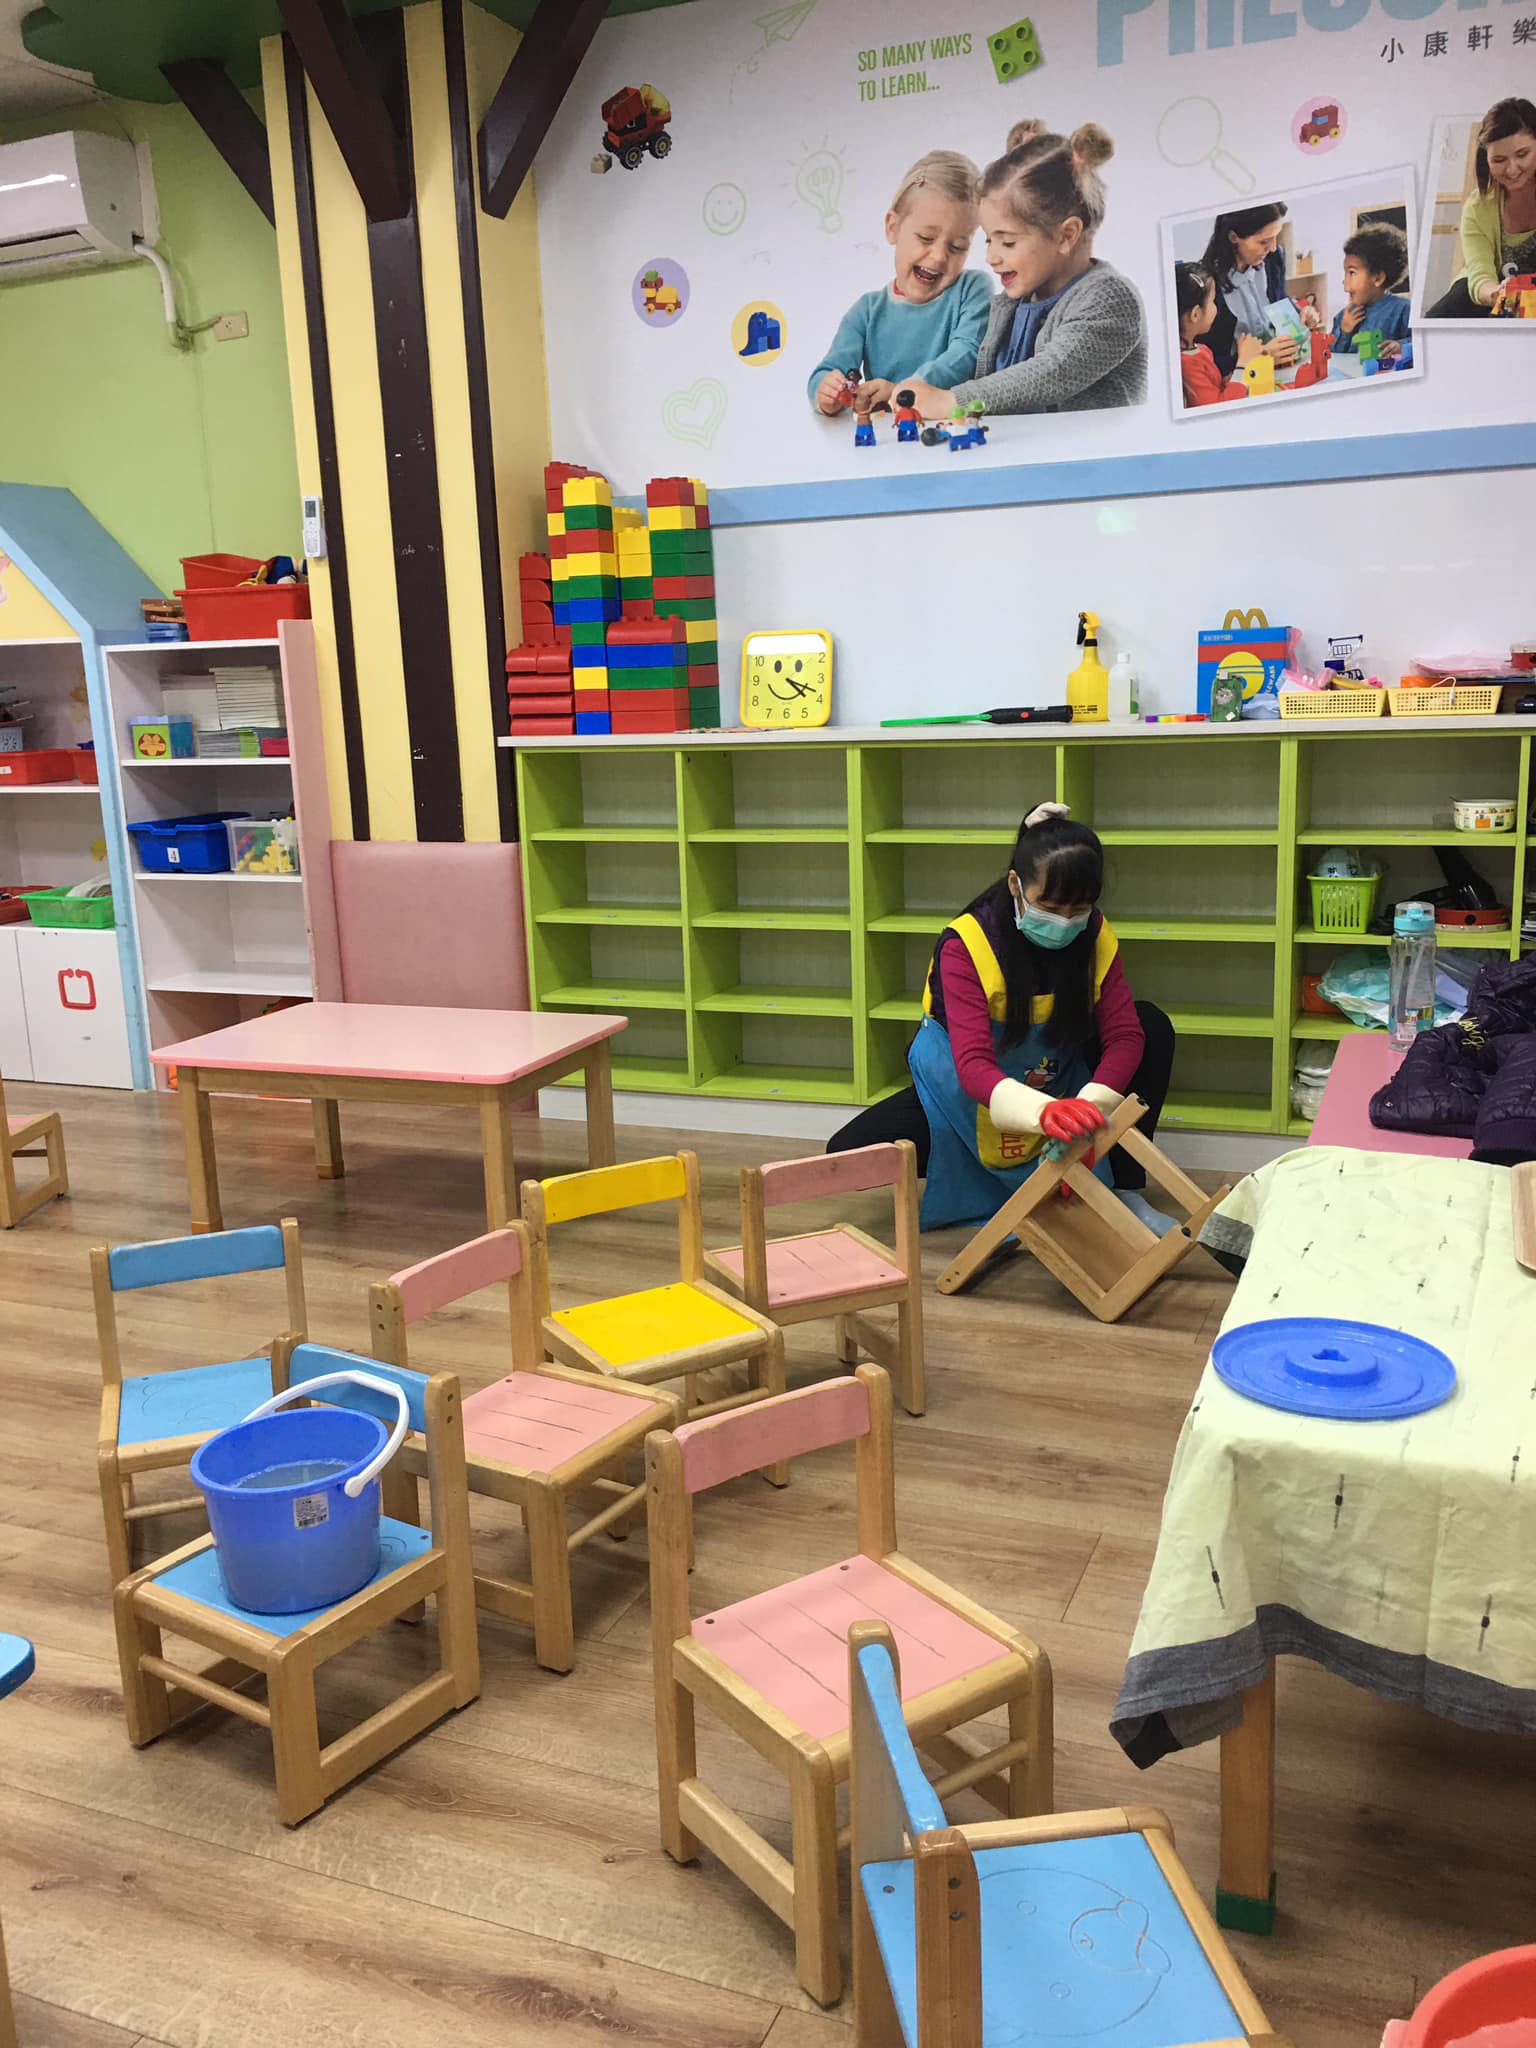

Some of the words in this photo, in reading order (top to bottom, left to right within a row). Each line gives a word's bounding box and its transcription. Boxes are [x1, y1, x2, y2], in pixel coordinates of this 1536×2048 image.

[857, 49, 877, 72] SO
[882, 40, 926, 68] MANY
[930, 33, 973, 60] WAYS
[858, 79, 877, 102] TO
[881, 71, 941, 98] LEARN...
[754, 655, 765, 667] 10
[818, 652, 826, 664] 2
[752, 675, 760, 686] 9
[817, 673, 825, 684] 3
[751, 695, 759, 707] 8
[816, 694, 824, 704] 4
[766, 708, 773, 719] 7
[783, 708, 791, 719] 6
[801, 707, 809, 719] 5
